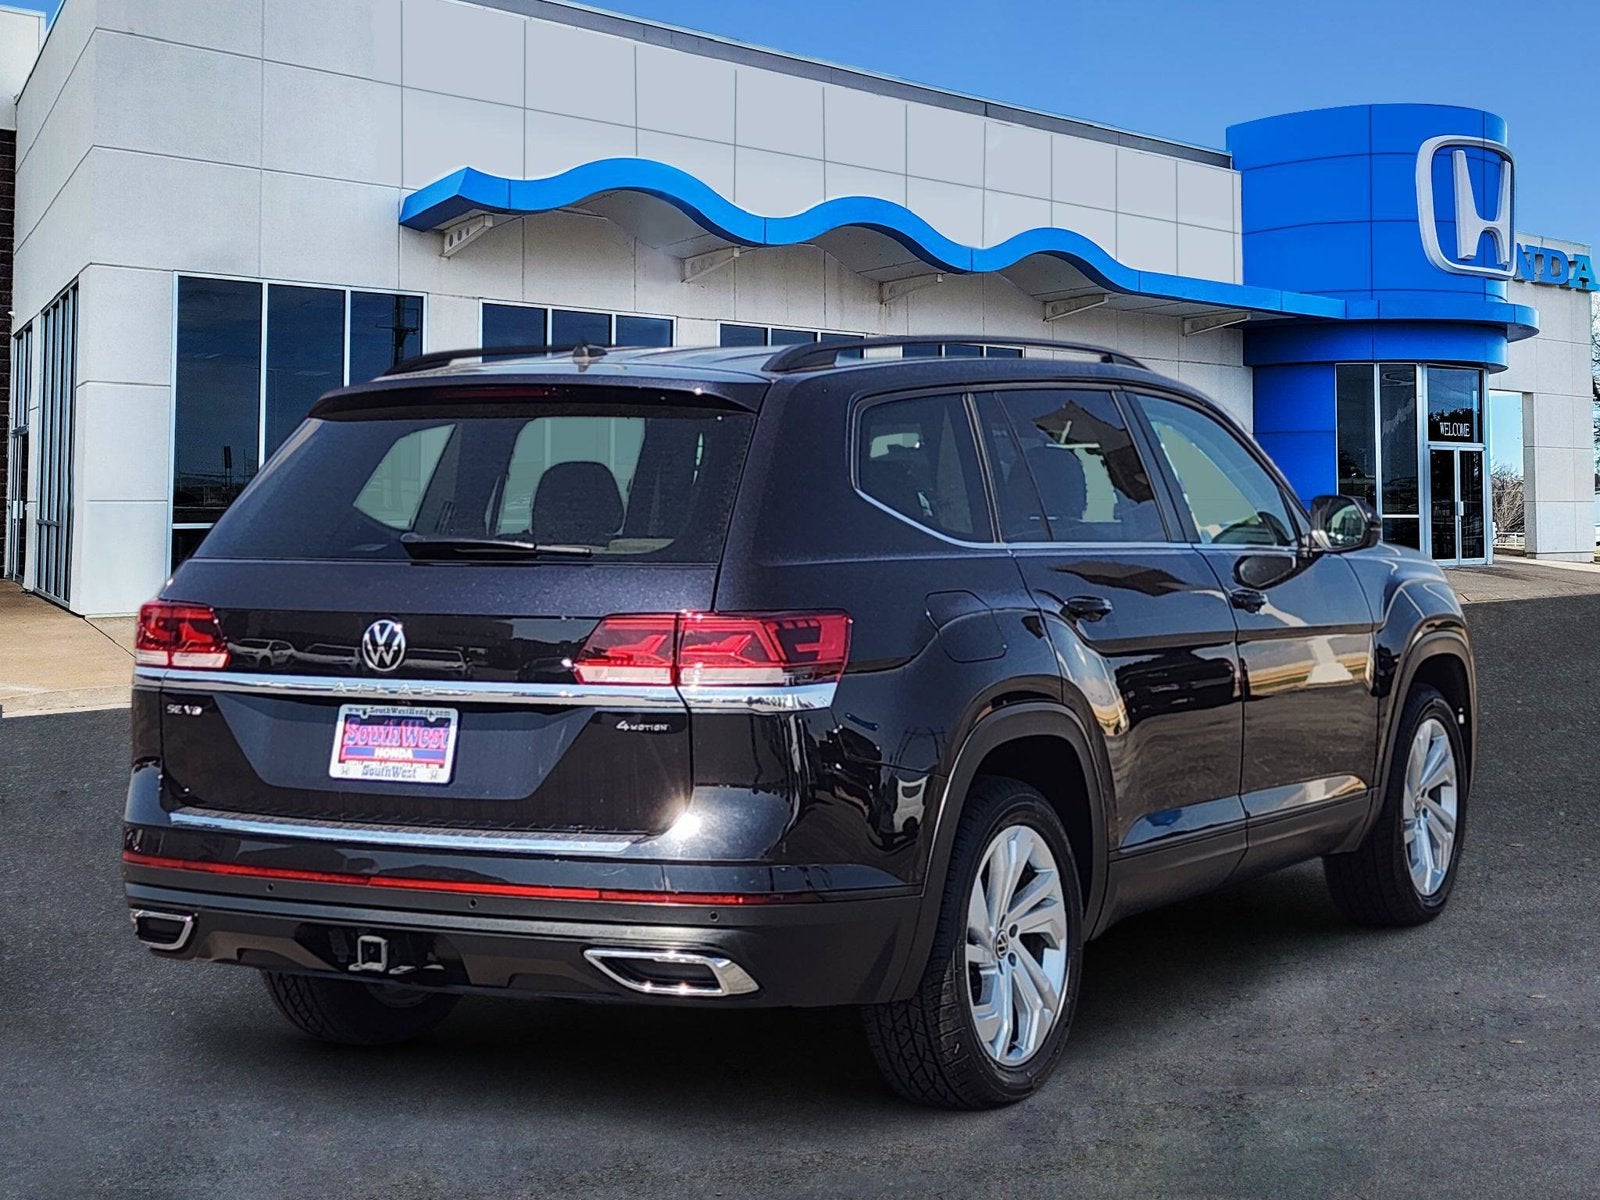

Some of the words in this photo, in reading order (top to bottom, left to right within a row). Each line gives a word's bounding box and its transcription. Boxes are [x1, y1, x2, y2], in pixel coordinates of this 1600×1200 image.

[1514, 243, 1600, 291] NDA
[1439, 422, 1471, 437] WELCOME
[615, 720, 669, 731] 4MOTION
